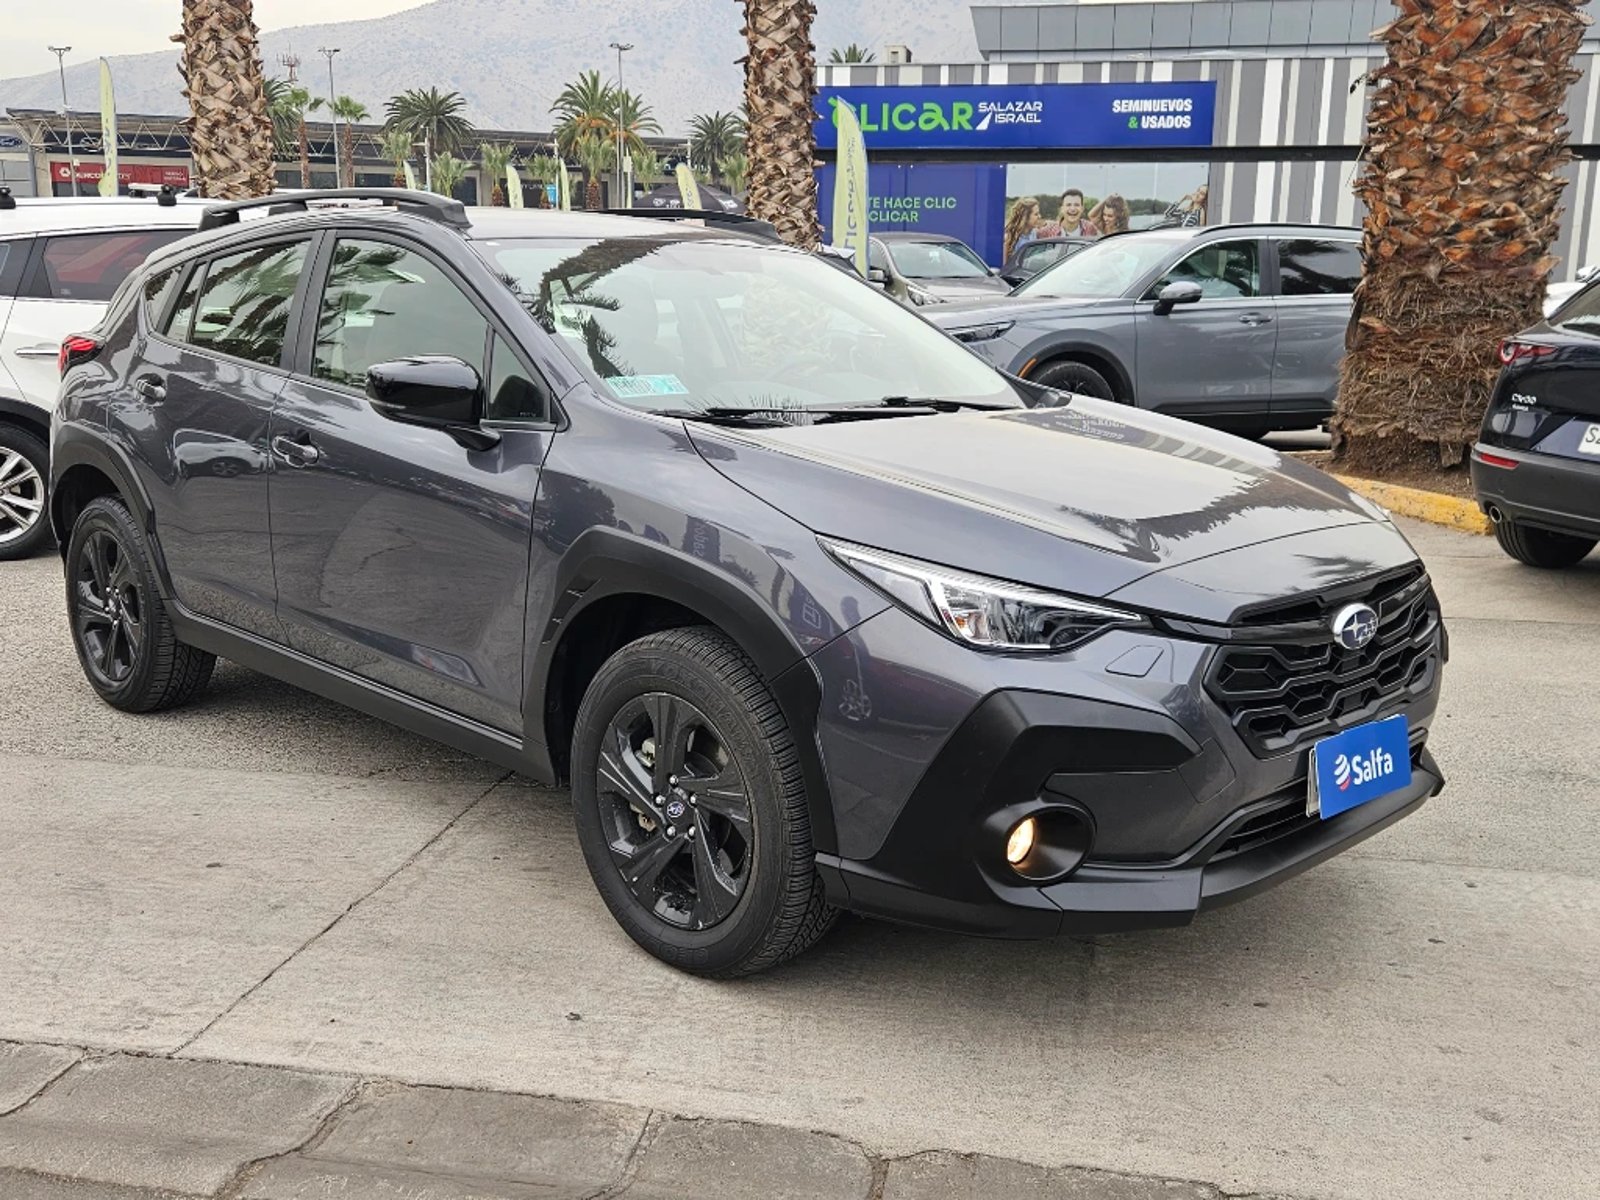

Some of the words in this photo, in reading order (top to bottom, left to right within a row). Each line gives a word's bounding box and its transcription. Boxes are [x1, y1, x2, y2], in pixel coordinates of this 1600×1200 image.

[978, 101, 1043, 112] SALAZAR
[1112, 98, 1193, 113] SEMINUEVOS
[995, 112, 1041, 123] ISRAEL
[1128, 116, 1138, 128] &
[1141, 115, 1191, 129] USADOS
[884, 197, 920, 208] HACE
[924, 197, 957, 208] CLIC
[868, 210, 919, 222] CLICAR
[1352, 747, 1393, 785] Salfa
